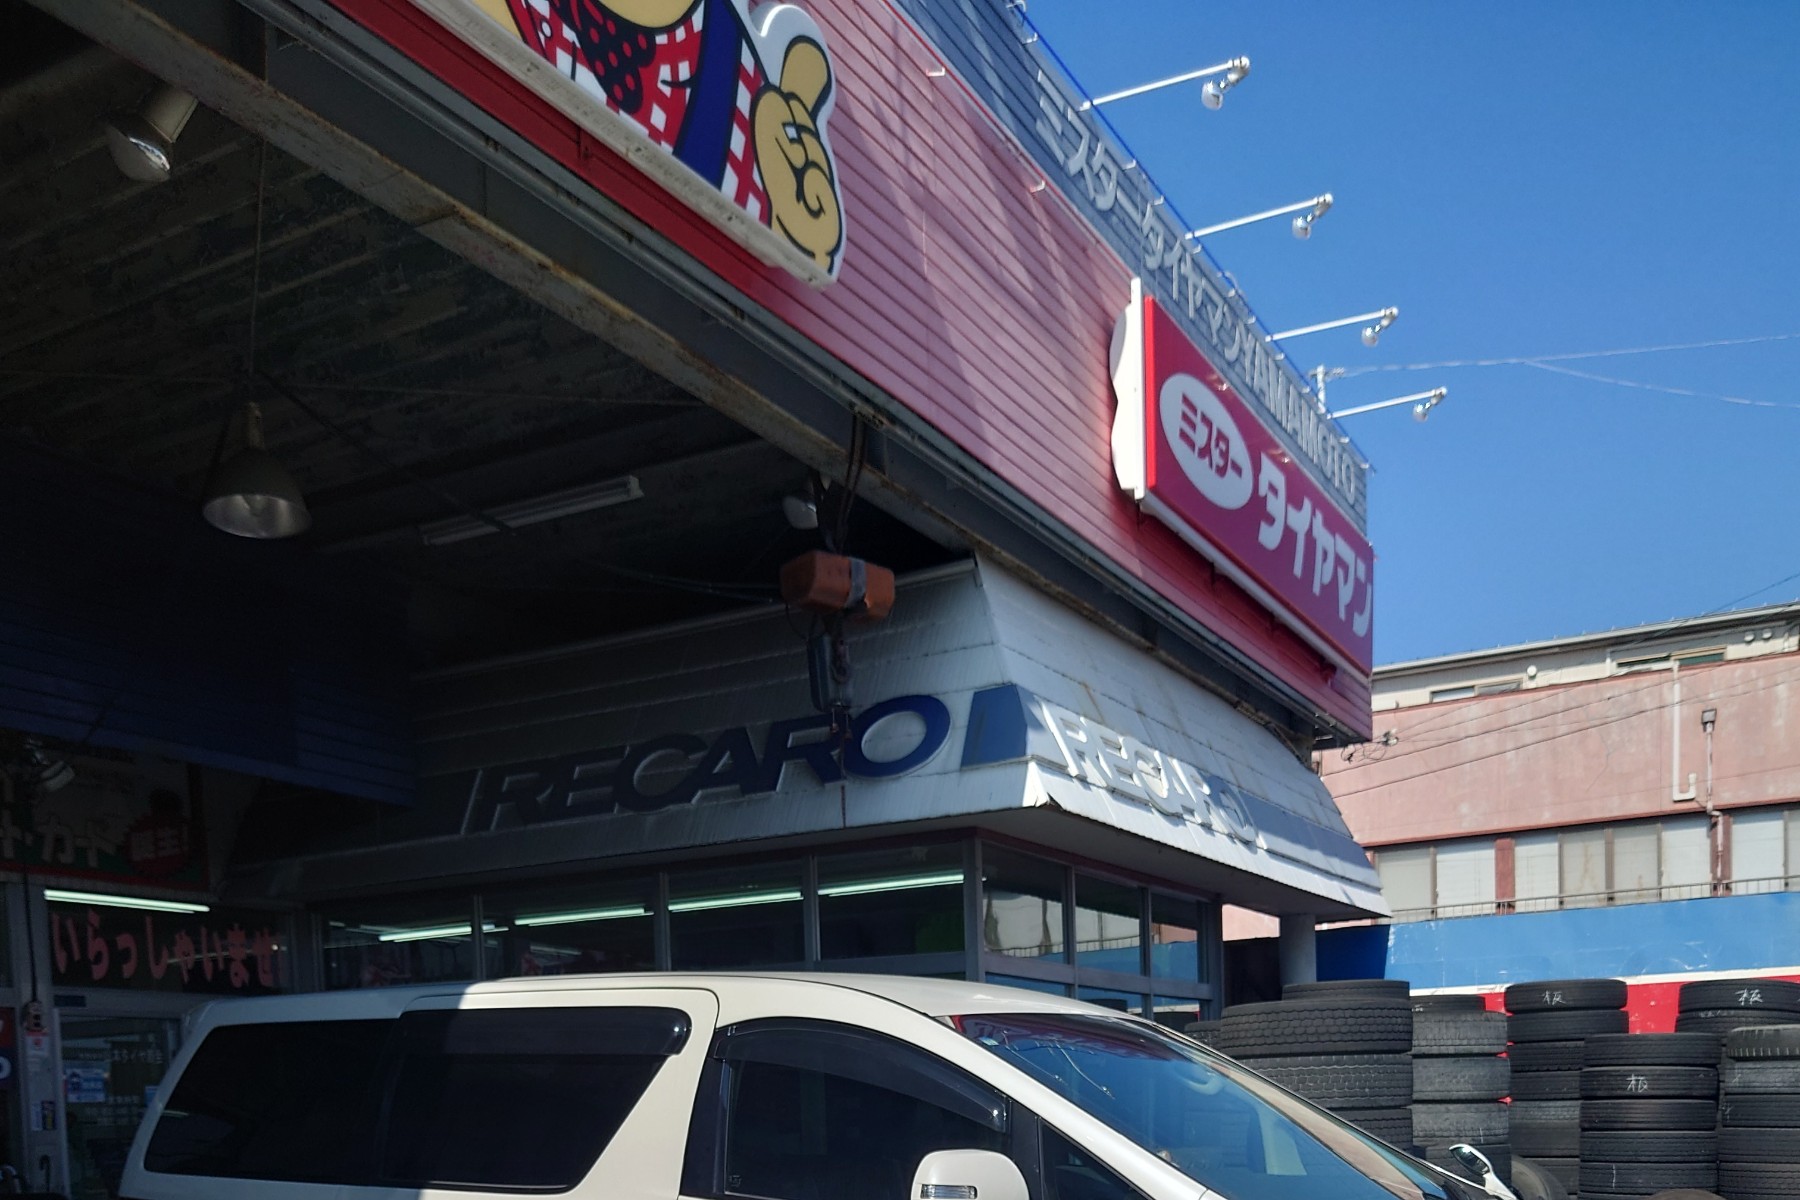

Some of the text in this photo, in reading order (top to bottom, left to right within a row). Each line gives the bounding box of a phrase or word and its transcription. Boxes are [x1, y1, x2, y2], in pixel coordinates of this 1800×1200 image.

[1177, 390, 1372, 638] ミスター タイヤマン
[478, 694, 947, 834] RECARO
[1039, 698, 1258, 843] RECARO
